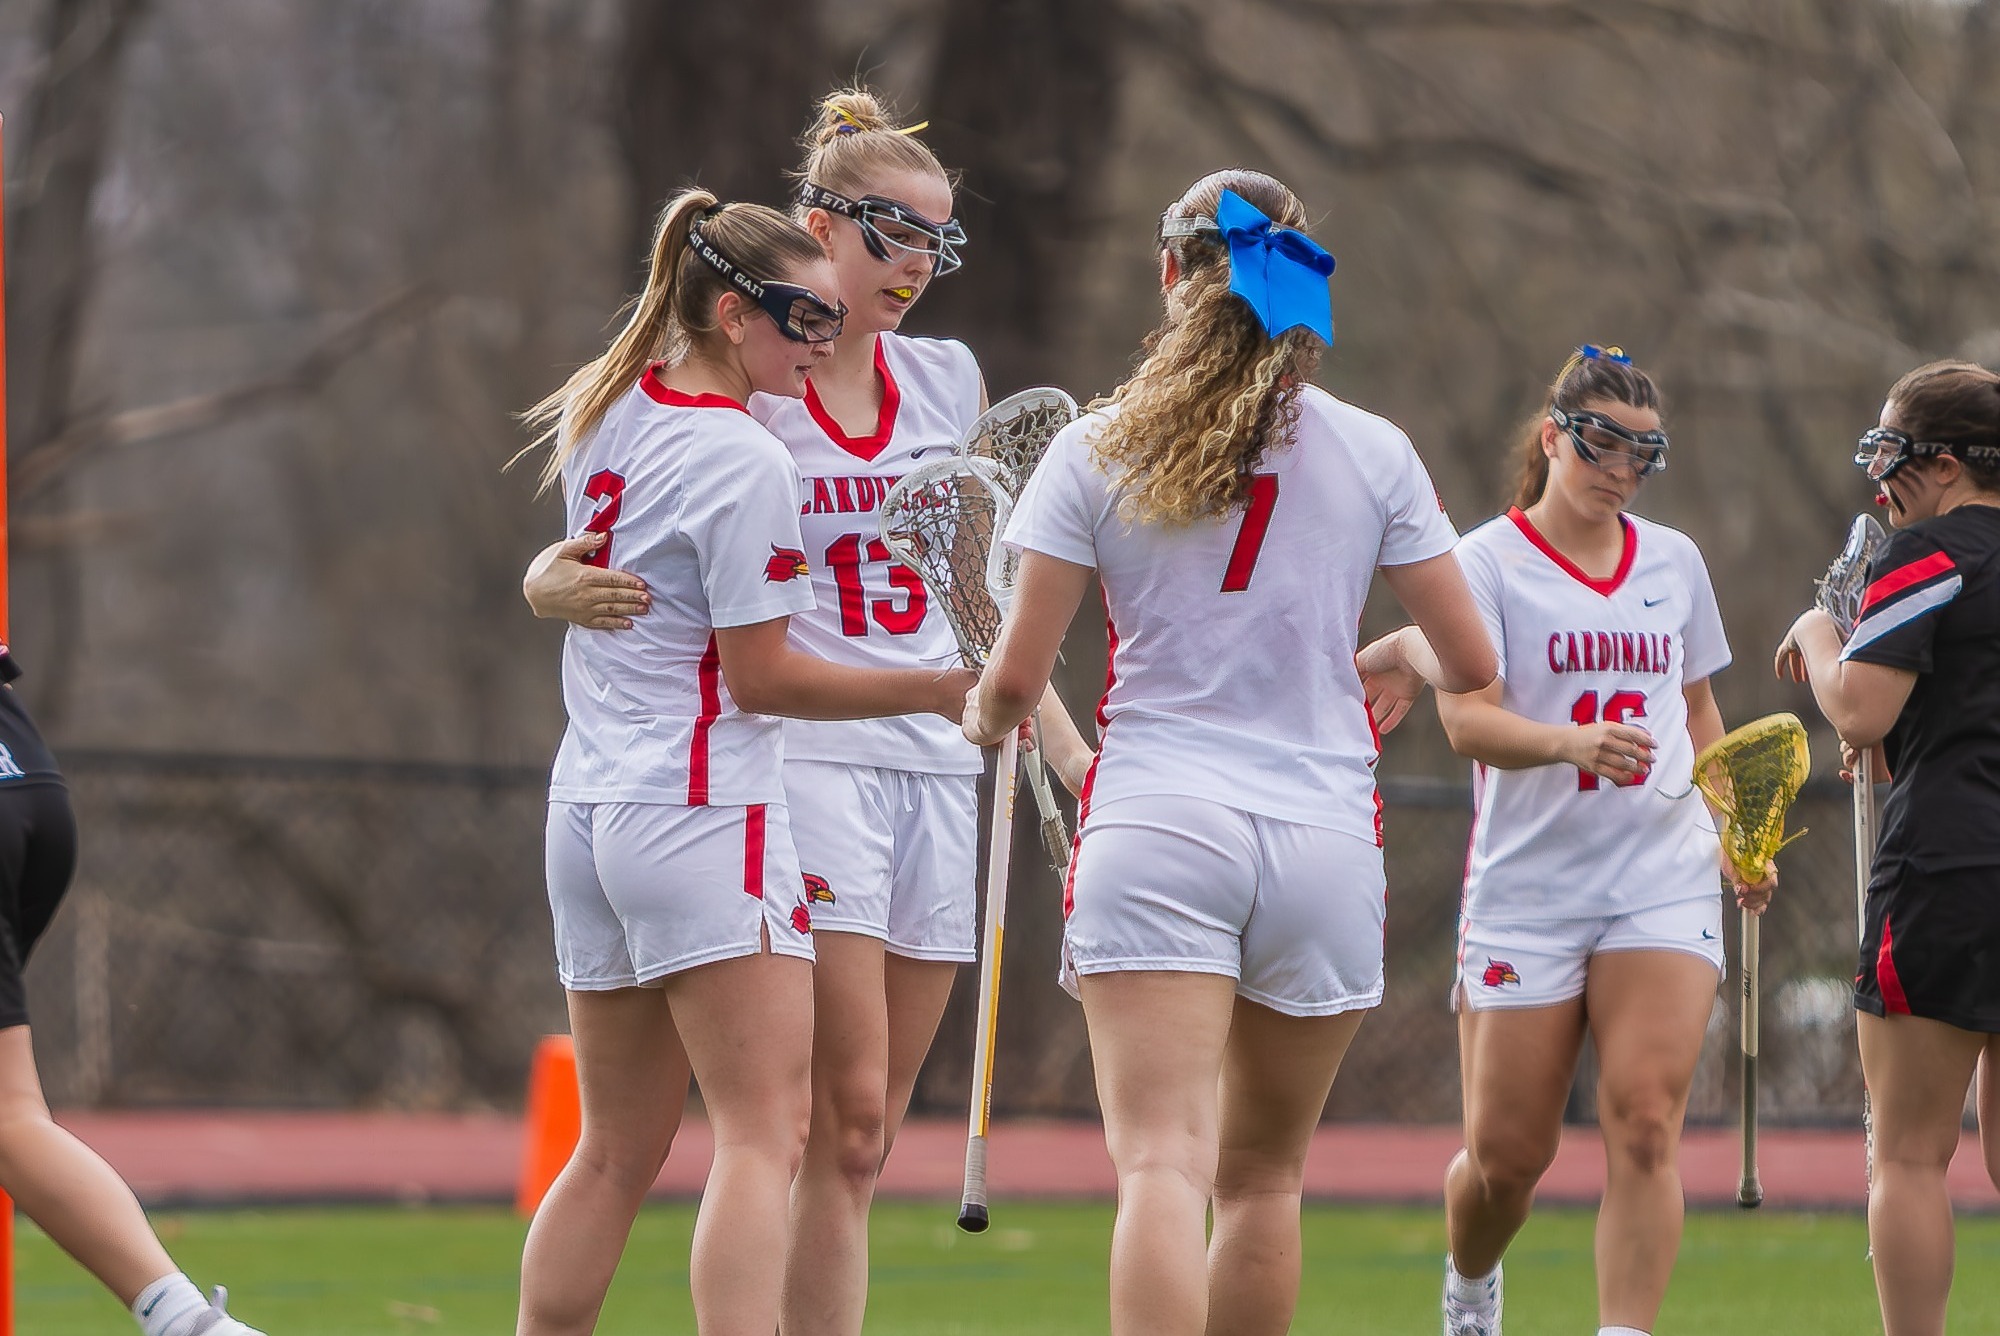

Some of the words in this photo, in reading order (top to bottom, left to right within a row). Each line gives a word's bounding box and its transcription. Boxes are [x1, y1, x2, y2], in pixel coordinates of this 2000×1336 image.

[820, 191, 853, 213] STX
[702, 246, 732, 273] GAIT
[1913, 442, 1953, 454] STX
[825, 533, 928, 637] 13
[1548, 630, 1672, 674] CARDINALS
